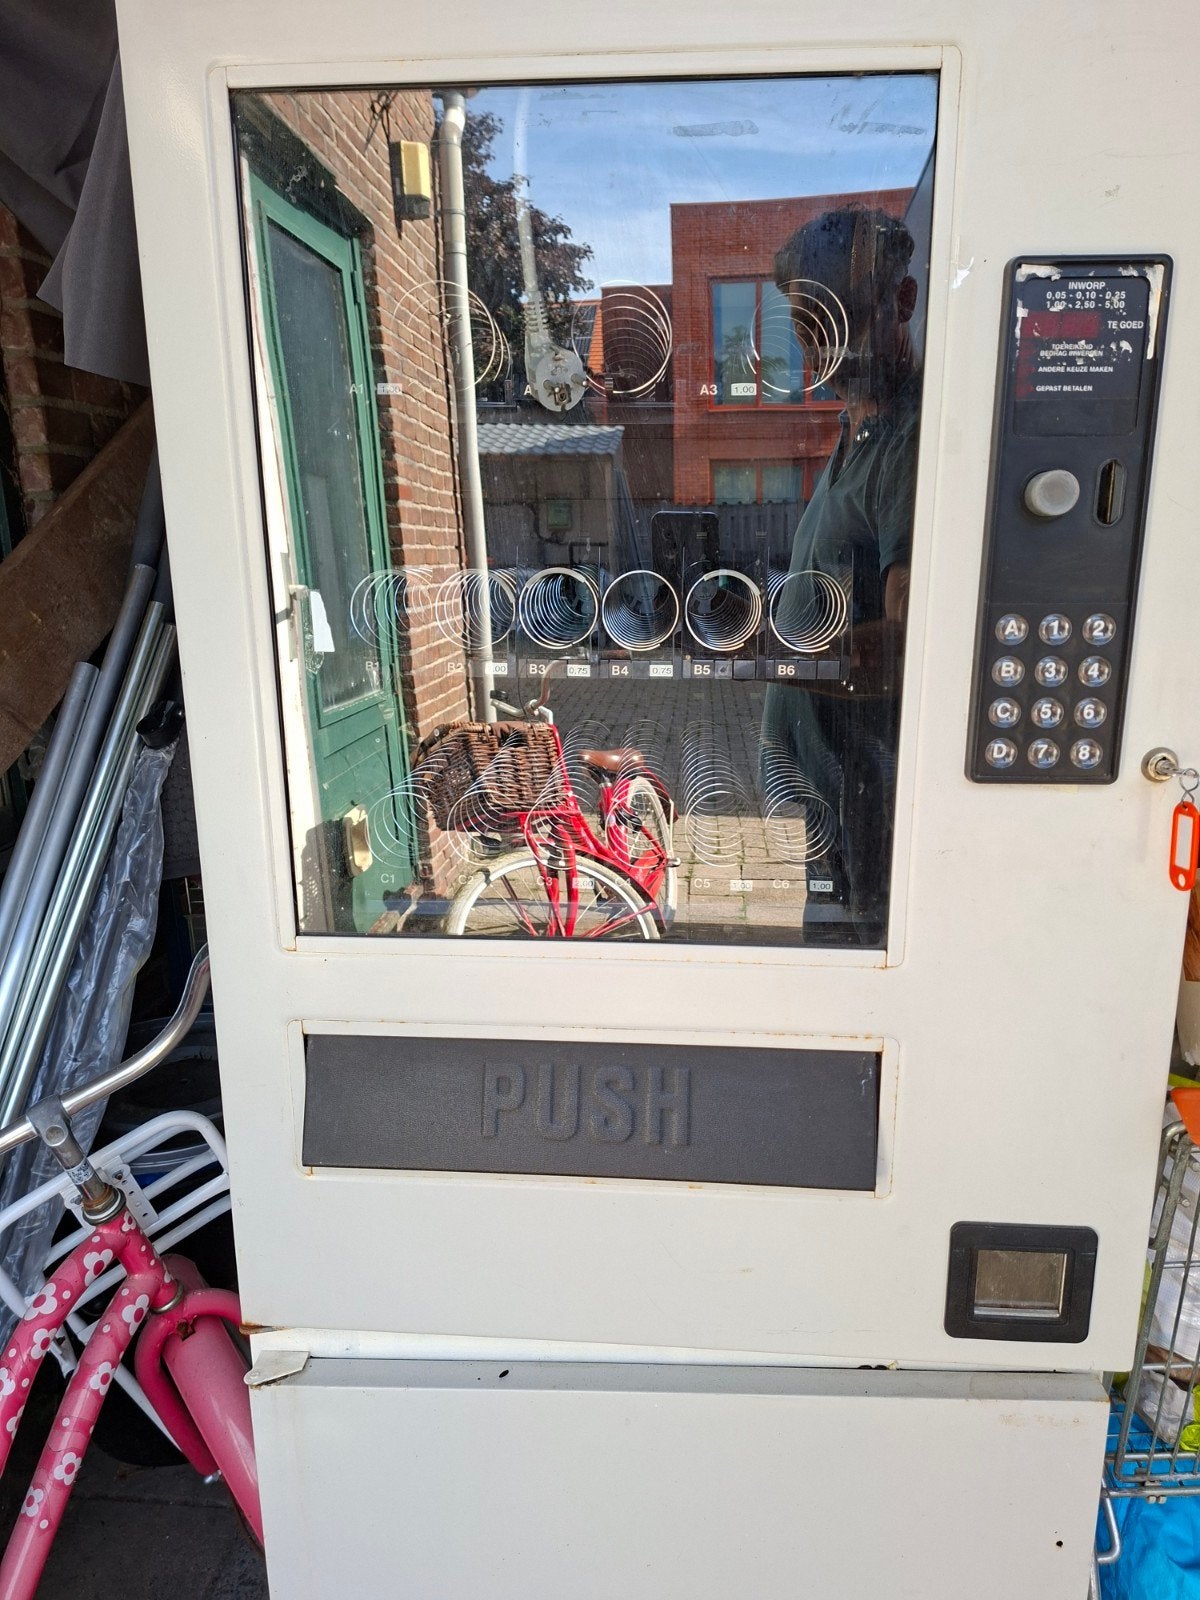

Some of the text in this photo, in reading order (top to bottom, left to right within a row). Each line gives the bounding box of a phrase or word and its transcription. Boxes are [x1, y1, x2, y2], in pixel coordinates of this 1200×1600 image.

[1068, 281, 1106, 290] INWORP
[1046, 291, 1066, 300] 0,05
[1076, 291, 1096, 300] 0,10
[1075, 300, 1096, 310] 2,50
[1107, 320, 1144, 329] TE GOED
[349, 383, 364, 394] A1
[523, 384, 533, 396] A
[700, 384, 718, 396] A3
[734, 385, 755, 394] 1.00
[1004, 620, 1105, 636] A 1 2
[528, 664, 546, 674] B3
[611, 665, 629, 676] B4
[693, 664, 711, 676] B5
[777, 664, 796, 676] B6
[1000, 662, 1100, 678] B 3 4
[996, 702, 1095, 720] C 5 6
[992, 744, 1090, 760] D 7 8
[380, 873, 395, 884] C1
[536, 875, 553, 886] C3
[694, 878, 711, 888] C5
[772, 879, 790, 889] C6
[480, 1057, 692, 1147] PUSH
